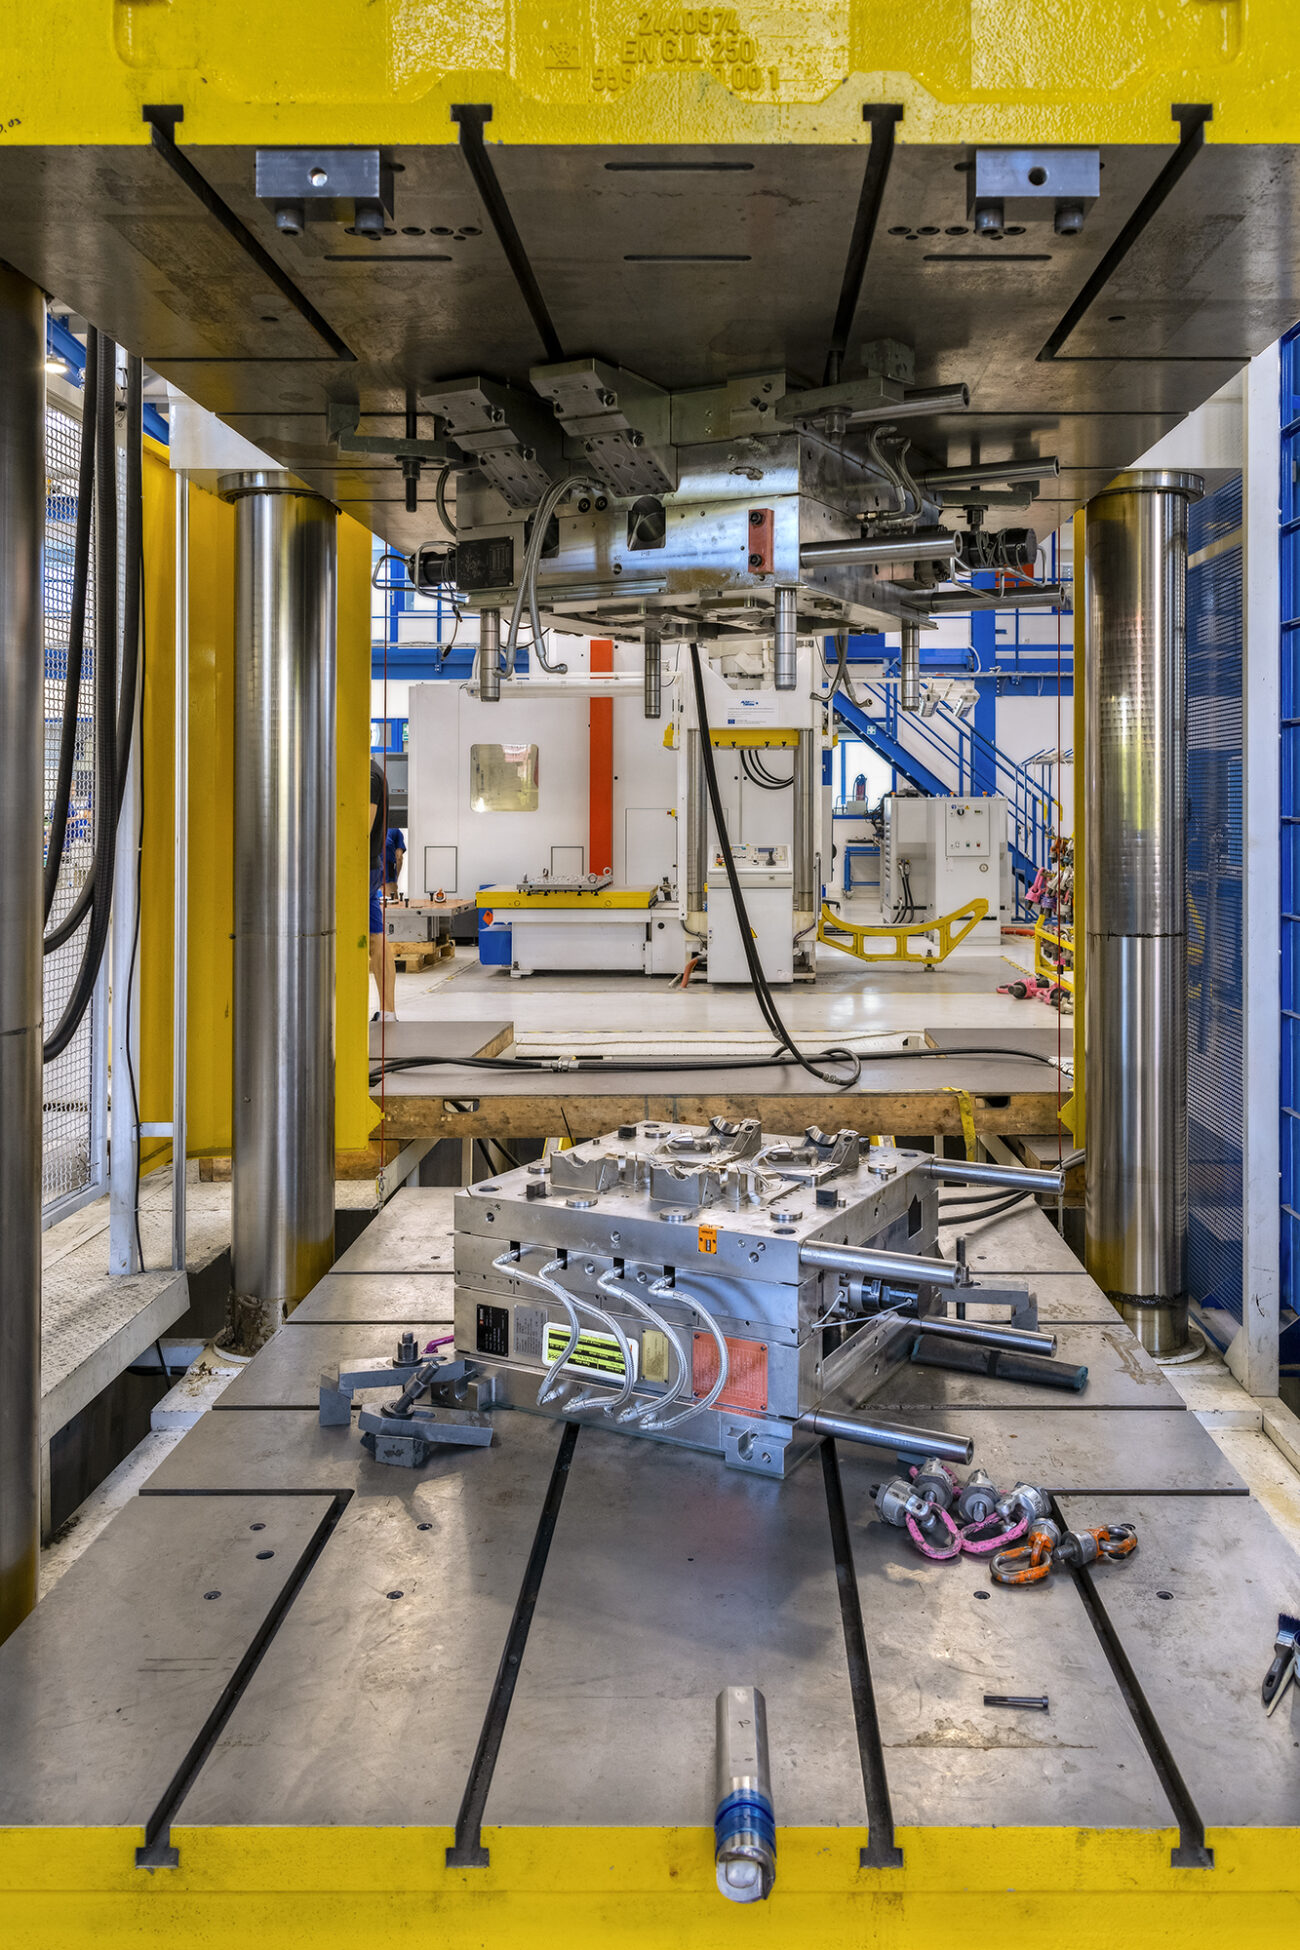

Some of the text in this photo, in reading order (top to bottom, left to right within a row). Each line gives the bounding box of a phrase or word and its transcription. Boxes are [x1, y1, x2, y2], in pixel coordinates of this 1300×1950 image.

[638, 11, 740, 37] 2440974
[621, 38, 755, 64] EN GJL 250
